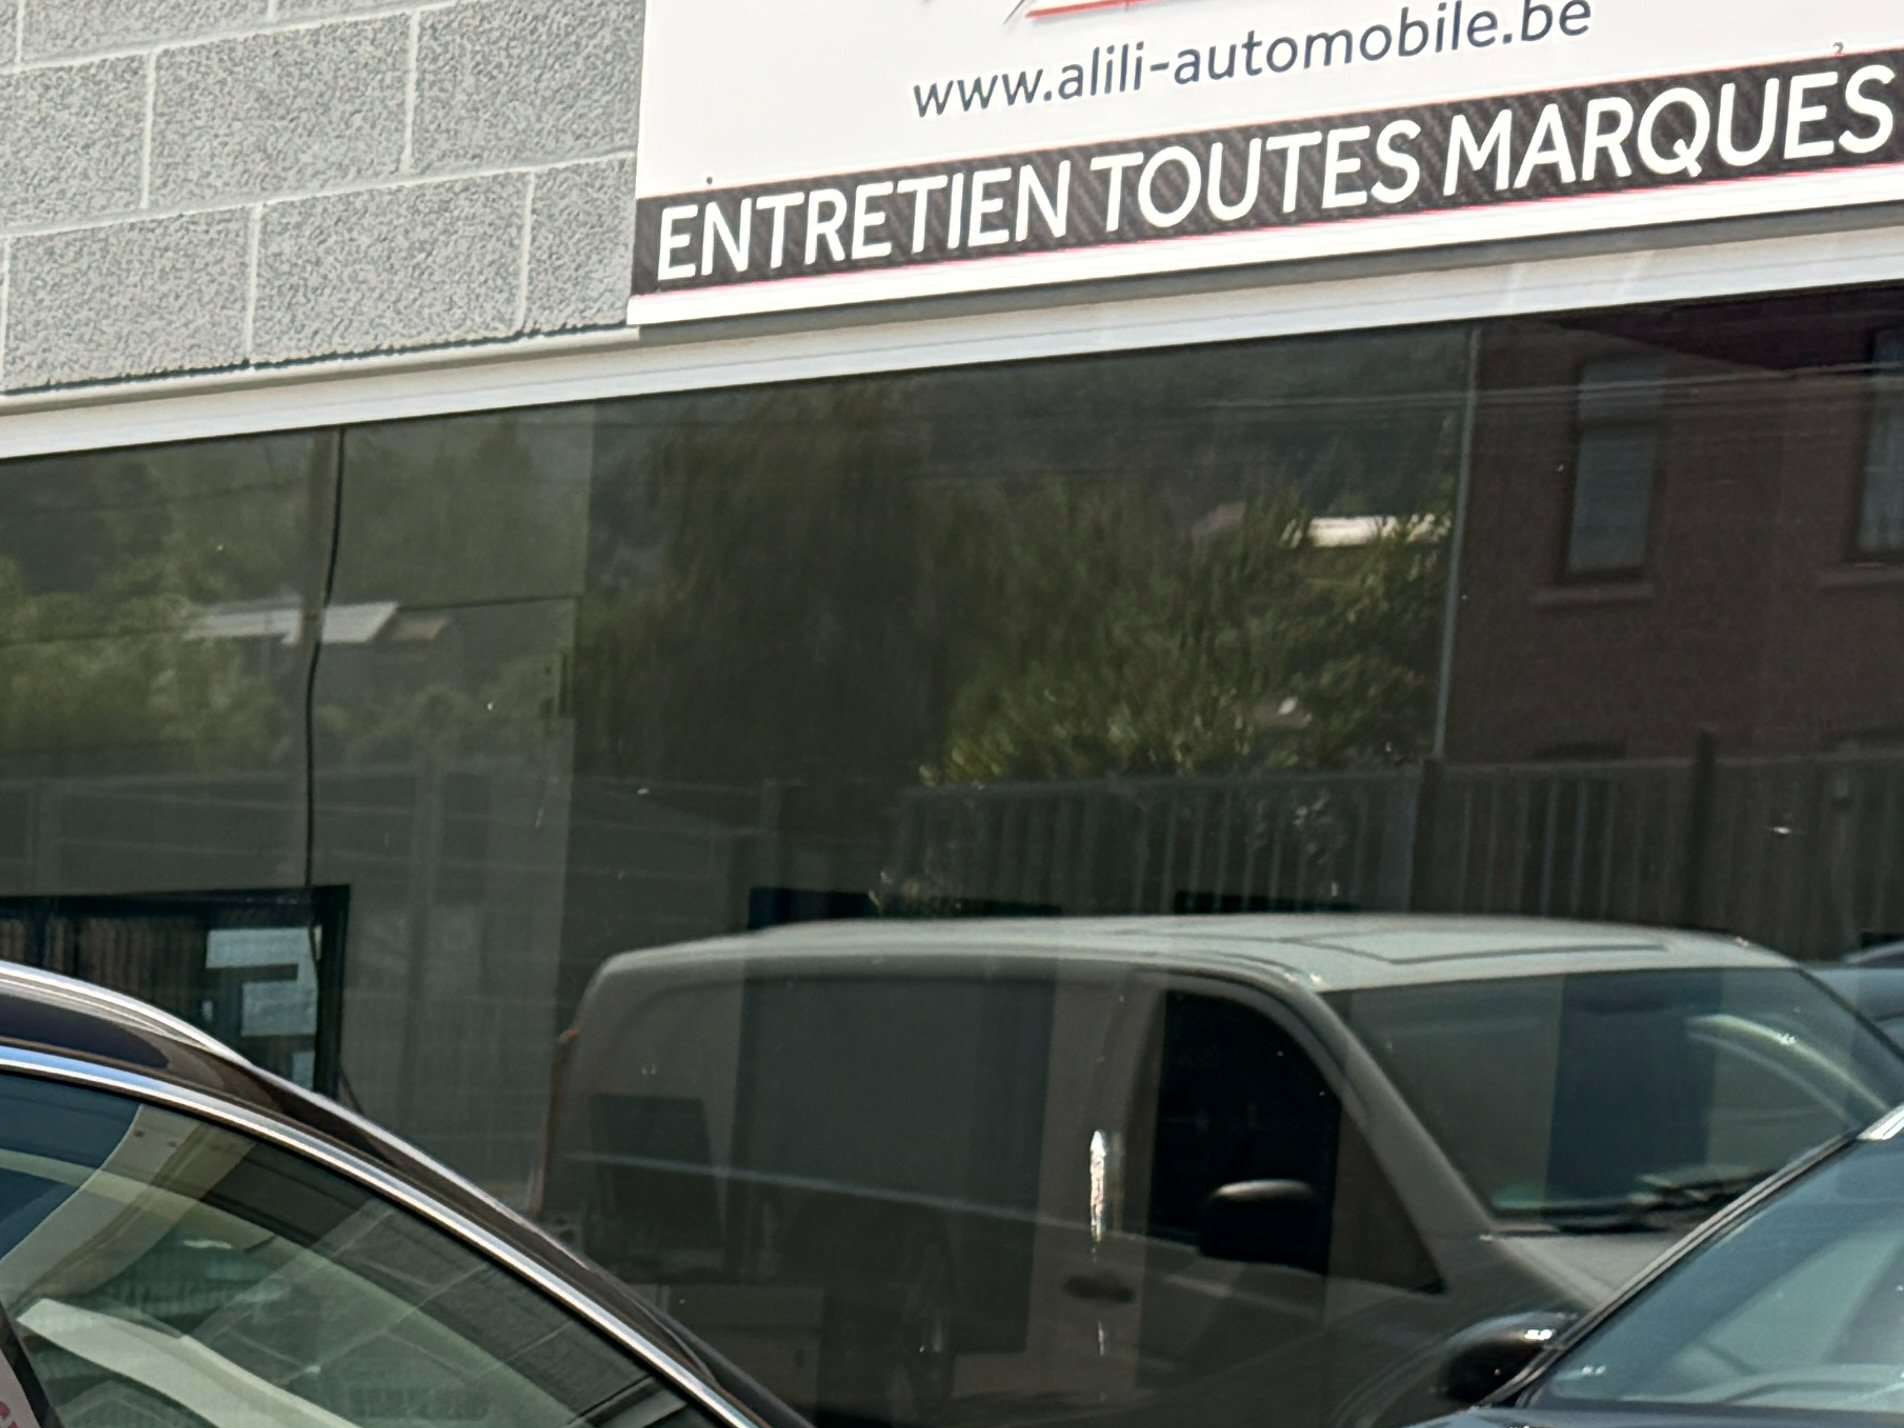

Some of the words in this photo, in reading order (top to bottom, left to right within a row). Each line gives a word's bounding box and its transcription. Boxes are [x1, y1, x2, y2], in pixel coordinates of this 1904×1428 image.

[912, 0, 1592, 118] www.alili-automobile.be
[656, 159, 1072, 282] ENTRETIEN
[1089, 118, 1422, 233] TOUTES
[1442, 63, 1897, 197] MARQUES
